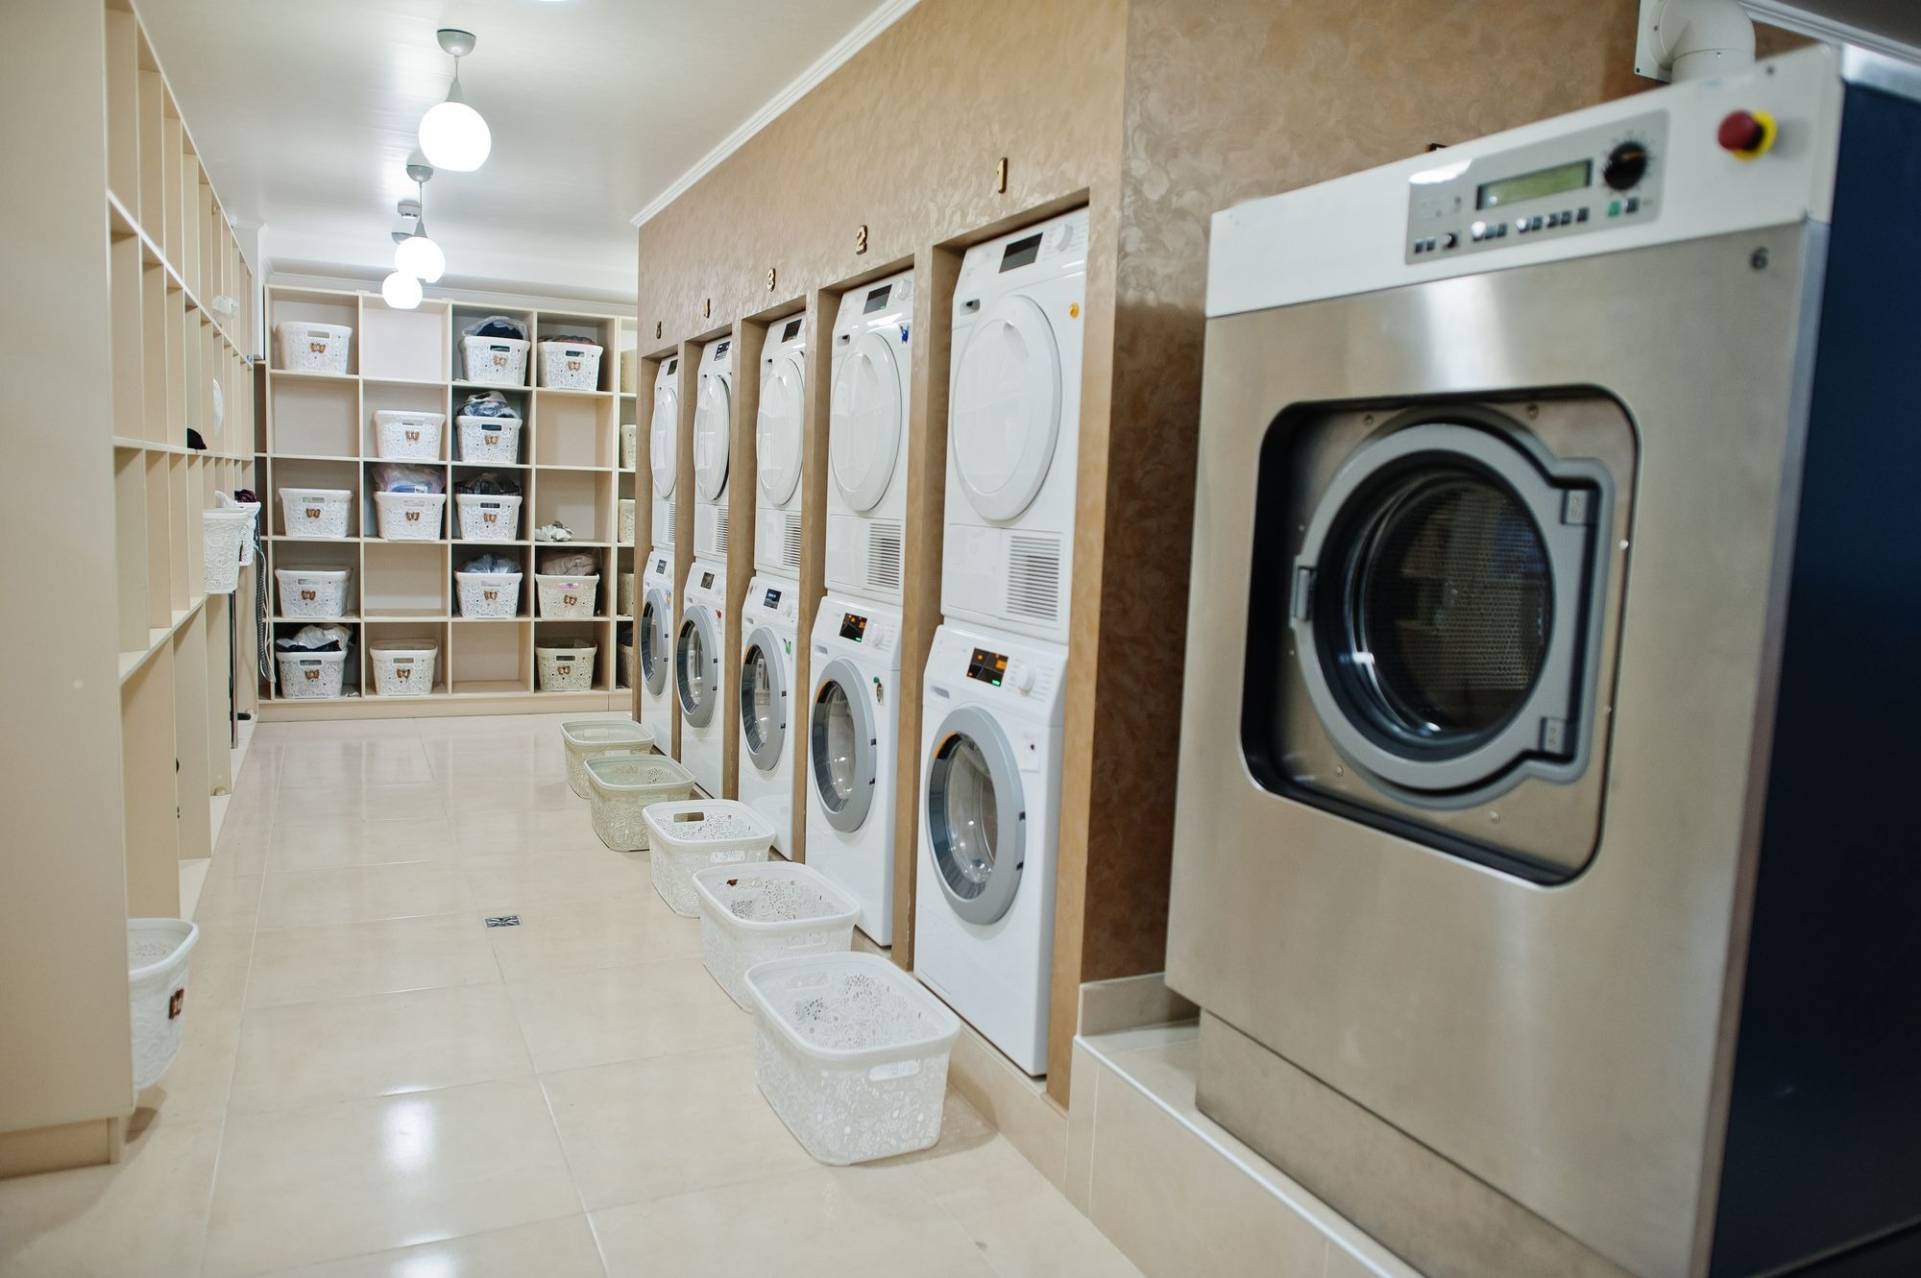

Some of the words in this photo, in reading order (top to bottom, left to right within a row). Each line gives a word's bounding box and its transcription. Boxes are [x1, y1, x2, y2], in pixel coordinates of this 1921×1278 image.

[996, 157, 1008, 194] 1
[856, 224, 868, 255] 2
[1749, 246, 1769, 271] 6
[767, 267, 776, 292] 3
